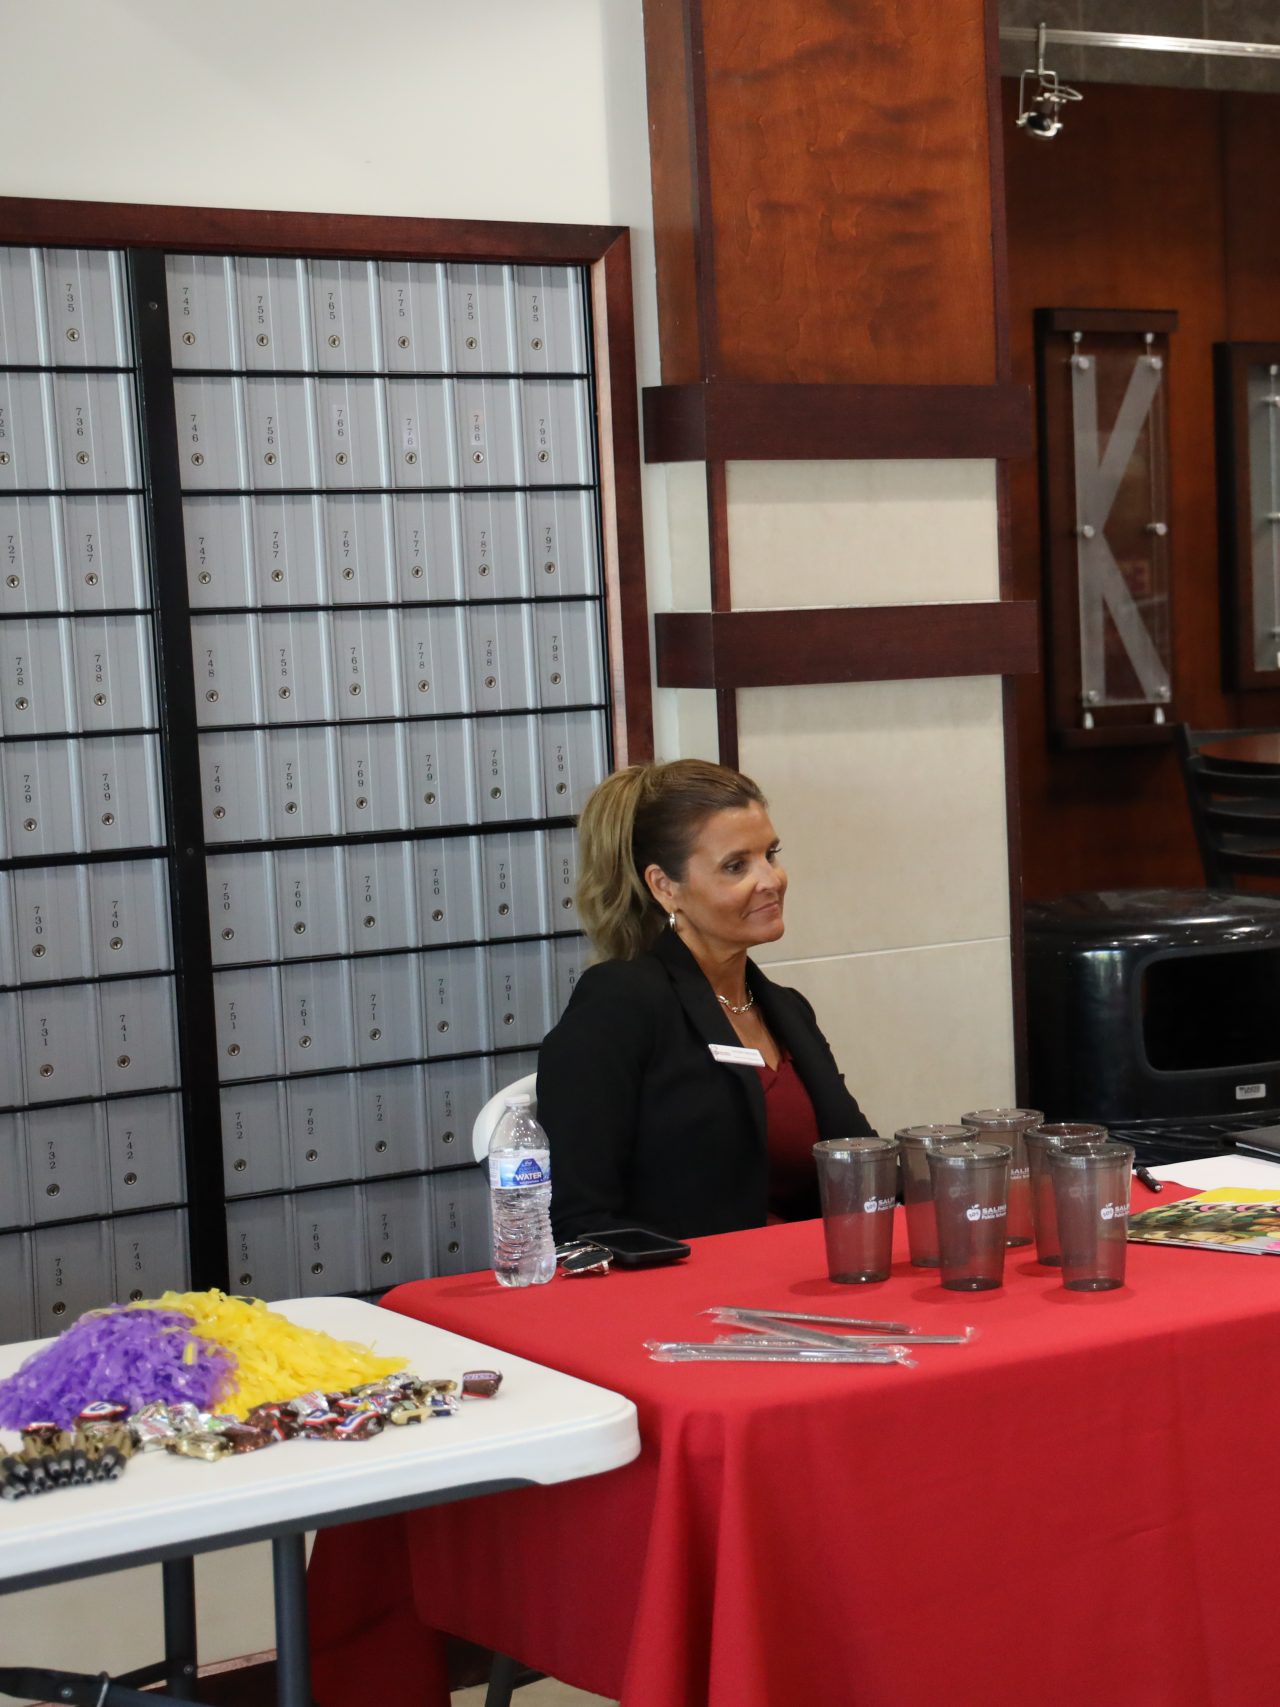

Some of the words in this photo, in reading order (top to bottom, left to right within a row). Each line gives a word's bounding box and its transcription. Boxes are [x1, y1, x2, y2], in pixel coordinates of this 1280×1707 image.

[65, 282, 75, 313] 735
[182, 286, 191, 316] 745
[256, 295, 265, 324] 755
[327, 291, 337, 321] 765
[397, 288, 406, 318] 775
[466, 292, 475, 321] 785
[531, 294, 540, 323] 795
[75, 406, 85, 437] 736
[190, 413, 200, 443] 746
[266, 416, 275, 445] 756
[336, 408, 345, 437] 766
[405, 417, 414, 446] 776
[473, 414, 481, 442] 786
[538, 418, 547, 446] 796
[272, 530, 280, 559] 757
[342, 530, 350, 558] 767
[412, 529, 420, 558] 777
[480, 530, 488, 558] 787
[544, 526, 553, 554] 797
[1072, 355, 1171, 707] K
[7, 534, 16, 565] 727
[85, 533, 94, 563] 737
[198, 536, 207, 565] 747
[279, 648, 288, 677] 758
[349, 646, 359, 675] 768
[417, 641, 426, 670] 778
[485, 639, 493, 667] 788
[551, 635, 559, 662] 798
[15, 656, 25, 687] 728
[93, 653, 103, 683] 738
[206, 649, 215, 678] 748
[356, 759, 365, 788] 769
[425, 753, 434, 782] 779
[490, 748, 499, 777] 789
[556, 745, 565, 773] 799
[23, 774, 33, 804] 729
[101, 772, 112, 802] 739
[213, 765, 222, 794] 749
[285, 762, 294, 791] 759
[432, 868, 441, 896] 780
[498, 863, 506, 890] 790
[562, 858, 570, 885] 800
[221, 882, 231, 911] 750
[293, 880, 303, 909] 760
[364, 875, 373, 903] 770
[33, 905, 44, 935] 730
[111, 900, 120, 929] 740
[437, 977, 446, 1005] 781
[504, 974, 512, 1002] 791
[228, 1001, 237, 1030] 751
[299, 998, 308, 1027] 761
[369, 993, 377, 1021] 771
[39, 1017, 49, 1047] 731
[119, 1013, 127, 1043] 741
[306, 1107, 315, 1136] 762
[375, 1094, 383, 1122] 772
[234, 1111, 244, 1140] 752
[47, 1140, 57, 1171] 732
[125, 1130, 134, 1160] 742
[514, 1171, 542, 1181] WATER
[132, 1242, 143, 1271] 743
[54, 1257, 63, 1287] 733
